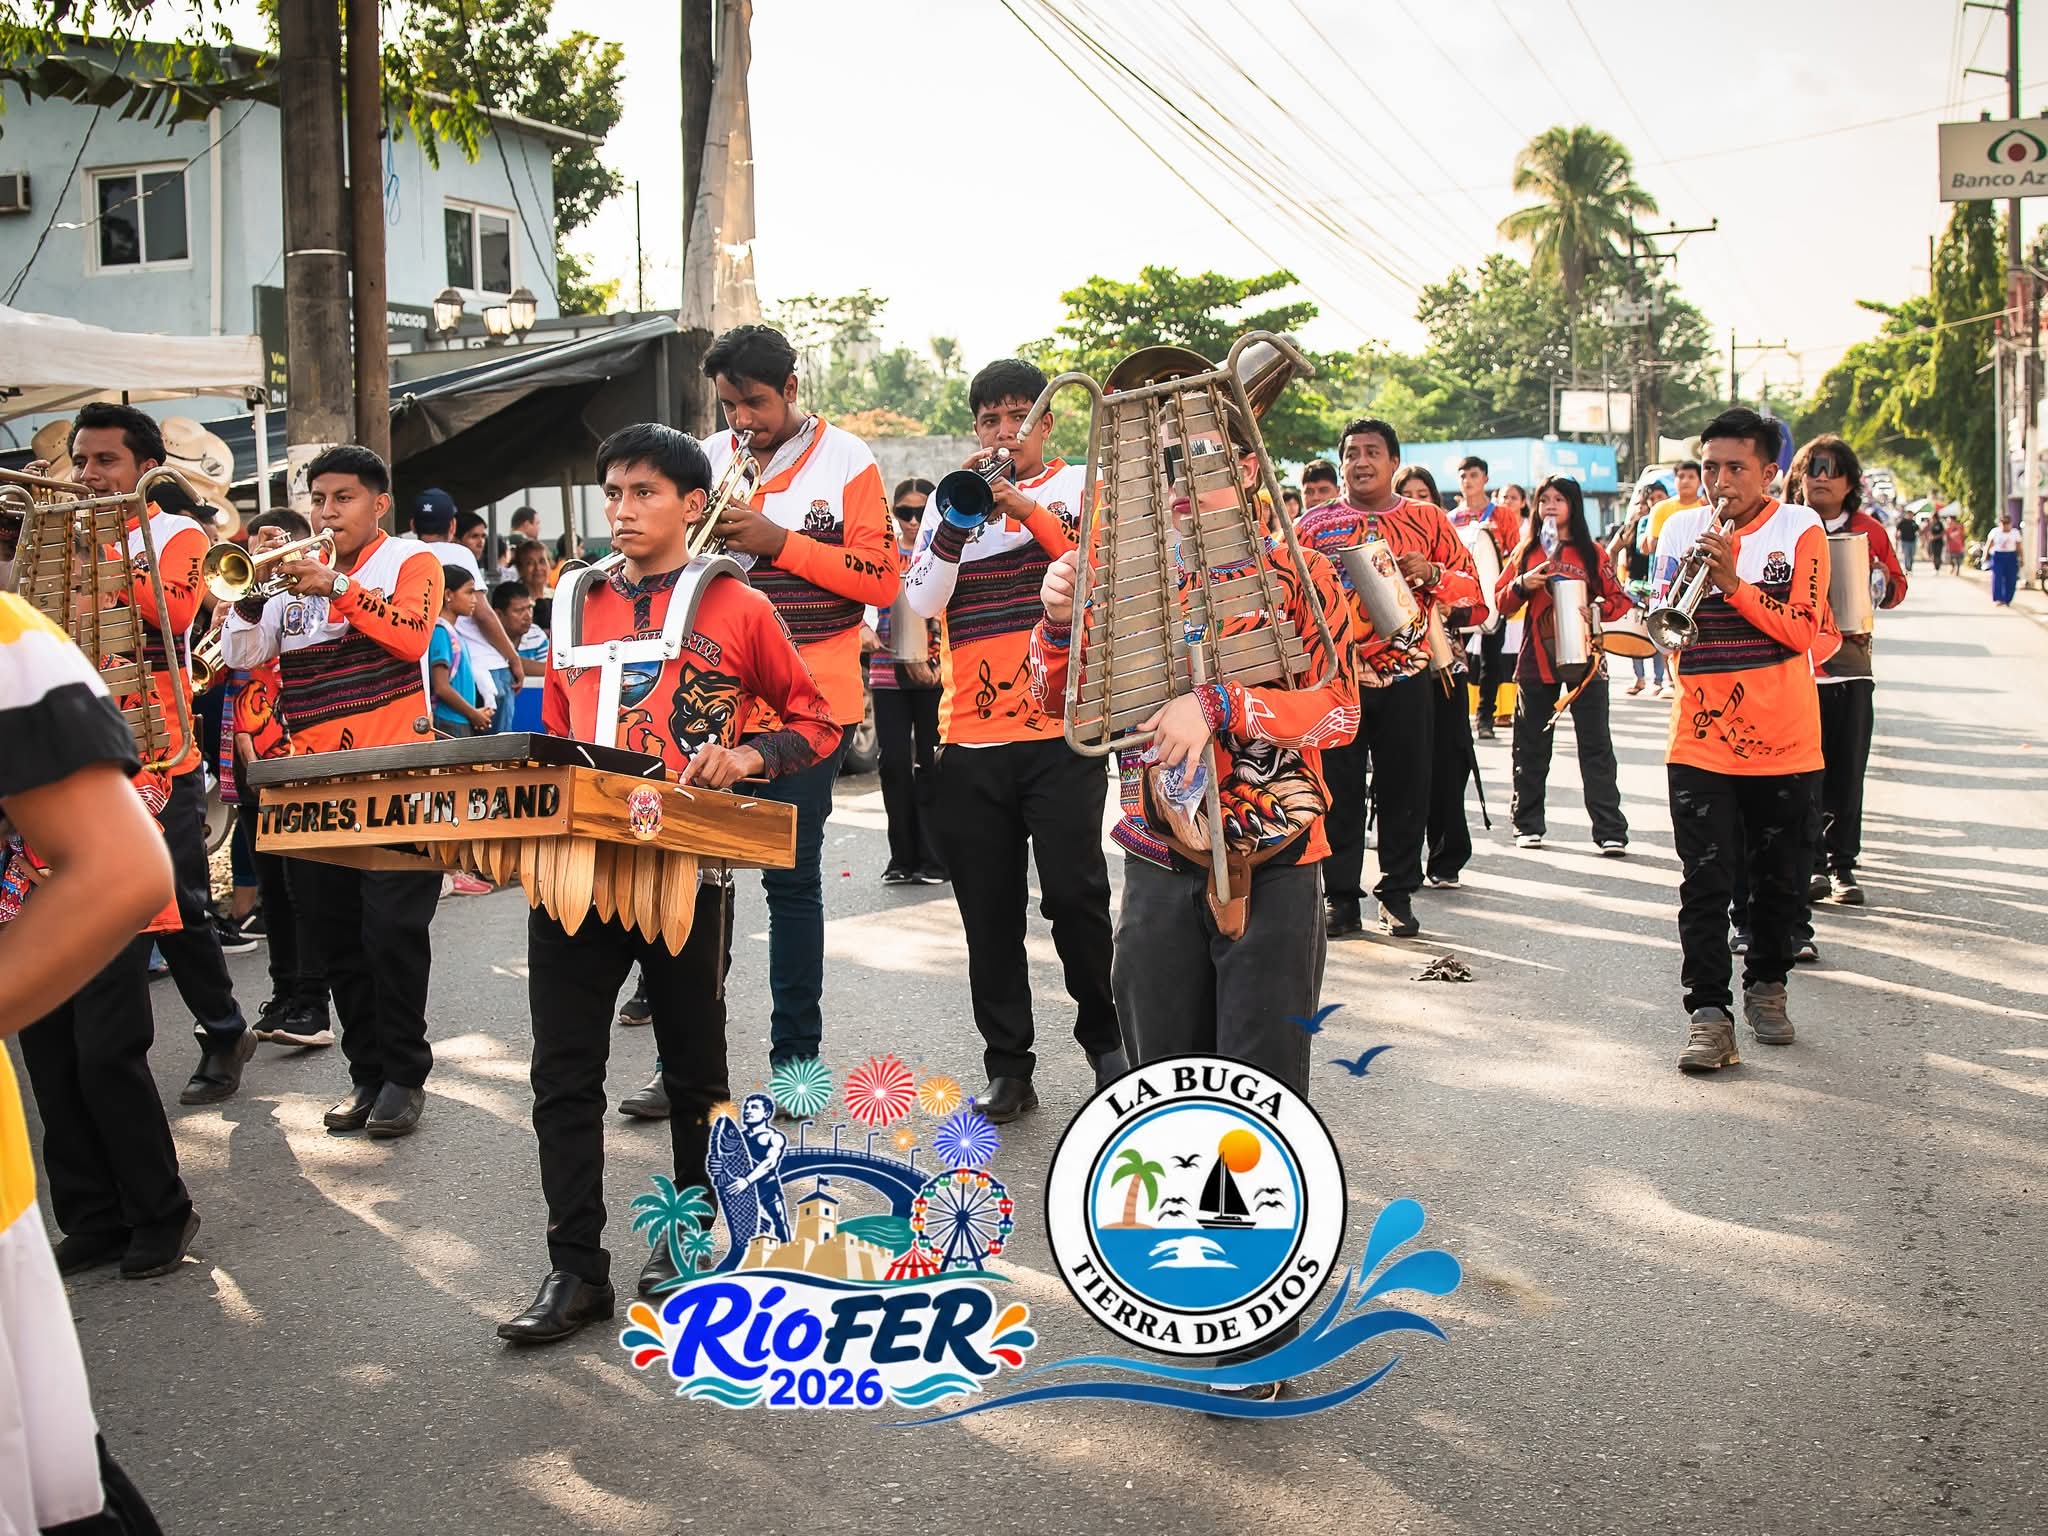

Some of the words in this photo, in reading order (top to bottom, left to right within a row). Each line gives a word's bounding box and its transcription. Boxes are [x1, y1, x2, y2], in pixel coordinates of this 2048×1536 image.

[1952, 173, 2015, 188] Banco
[386, 310, 428, 329] RVICIOS
[467, 784, 560, 821] BAND
